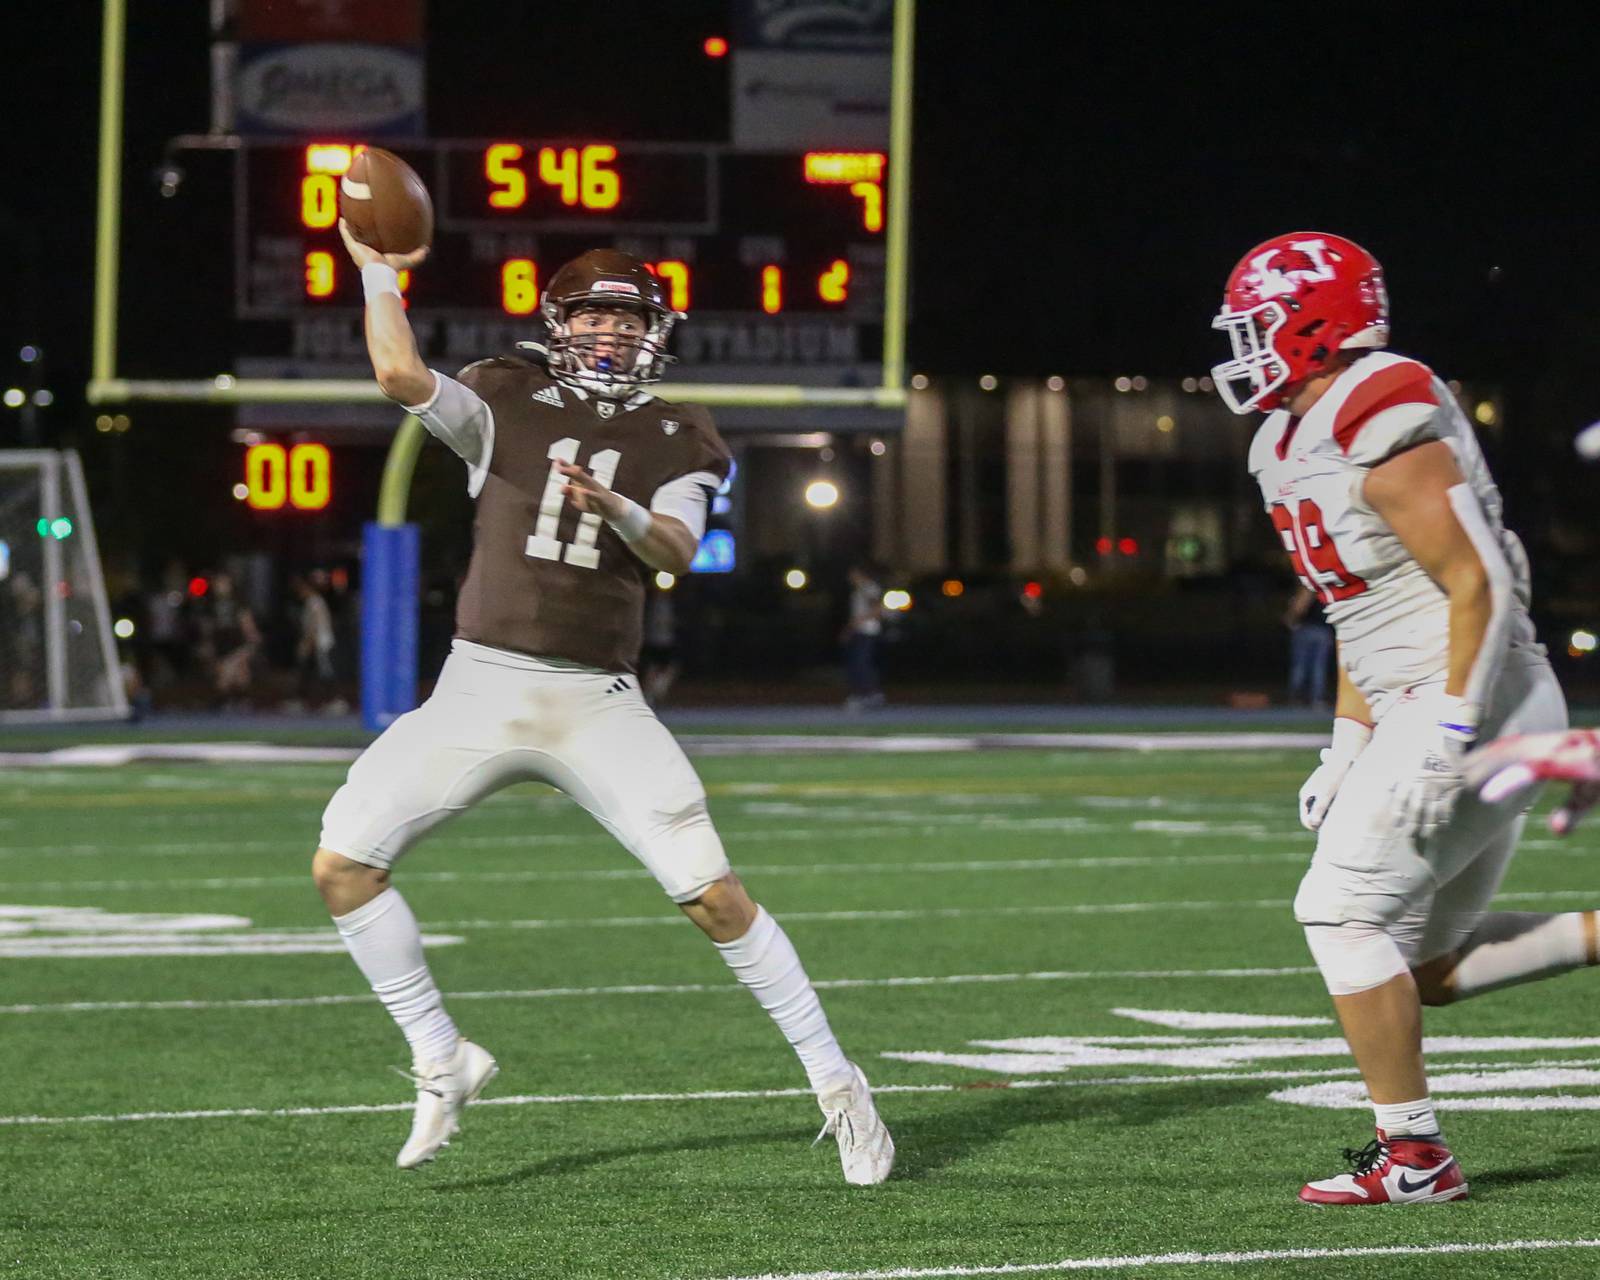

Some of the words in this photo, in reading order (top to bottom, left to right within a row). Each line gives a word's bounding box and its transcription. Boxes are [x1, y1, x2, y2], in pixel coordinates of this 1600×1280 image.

[301, 174, 337, 228] 0
[485, 143, 527, 208] 5
[538, 144, 620, 209] 46
[850, 181, 883, 232] 7
[502, 259, 539, 315] 6
[762, 264, 782, 314] 1
[246, 443, 331, 510] 00
[525, 437, 622, 570] 11
